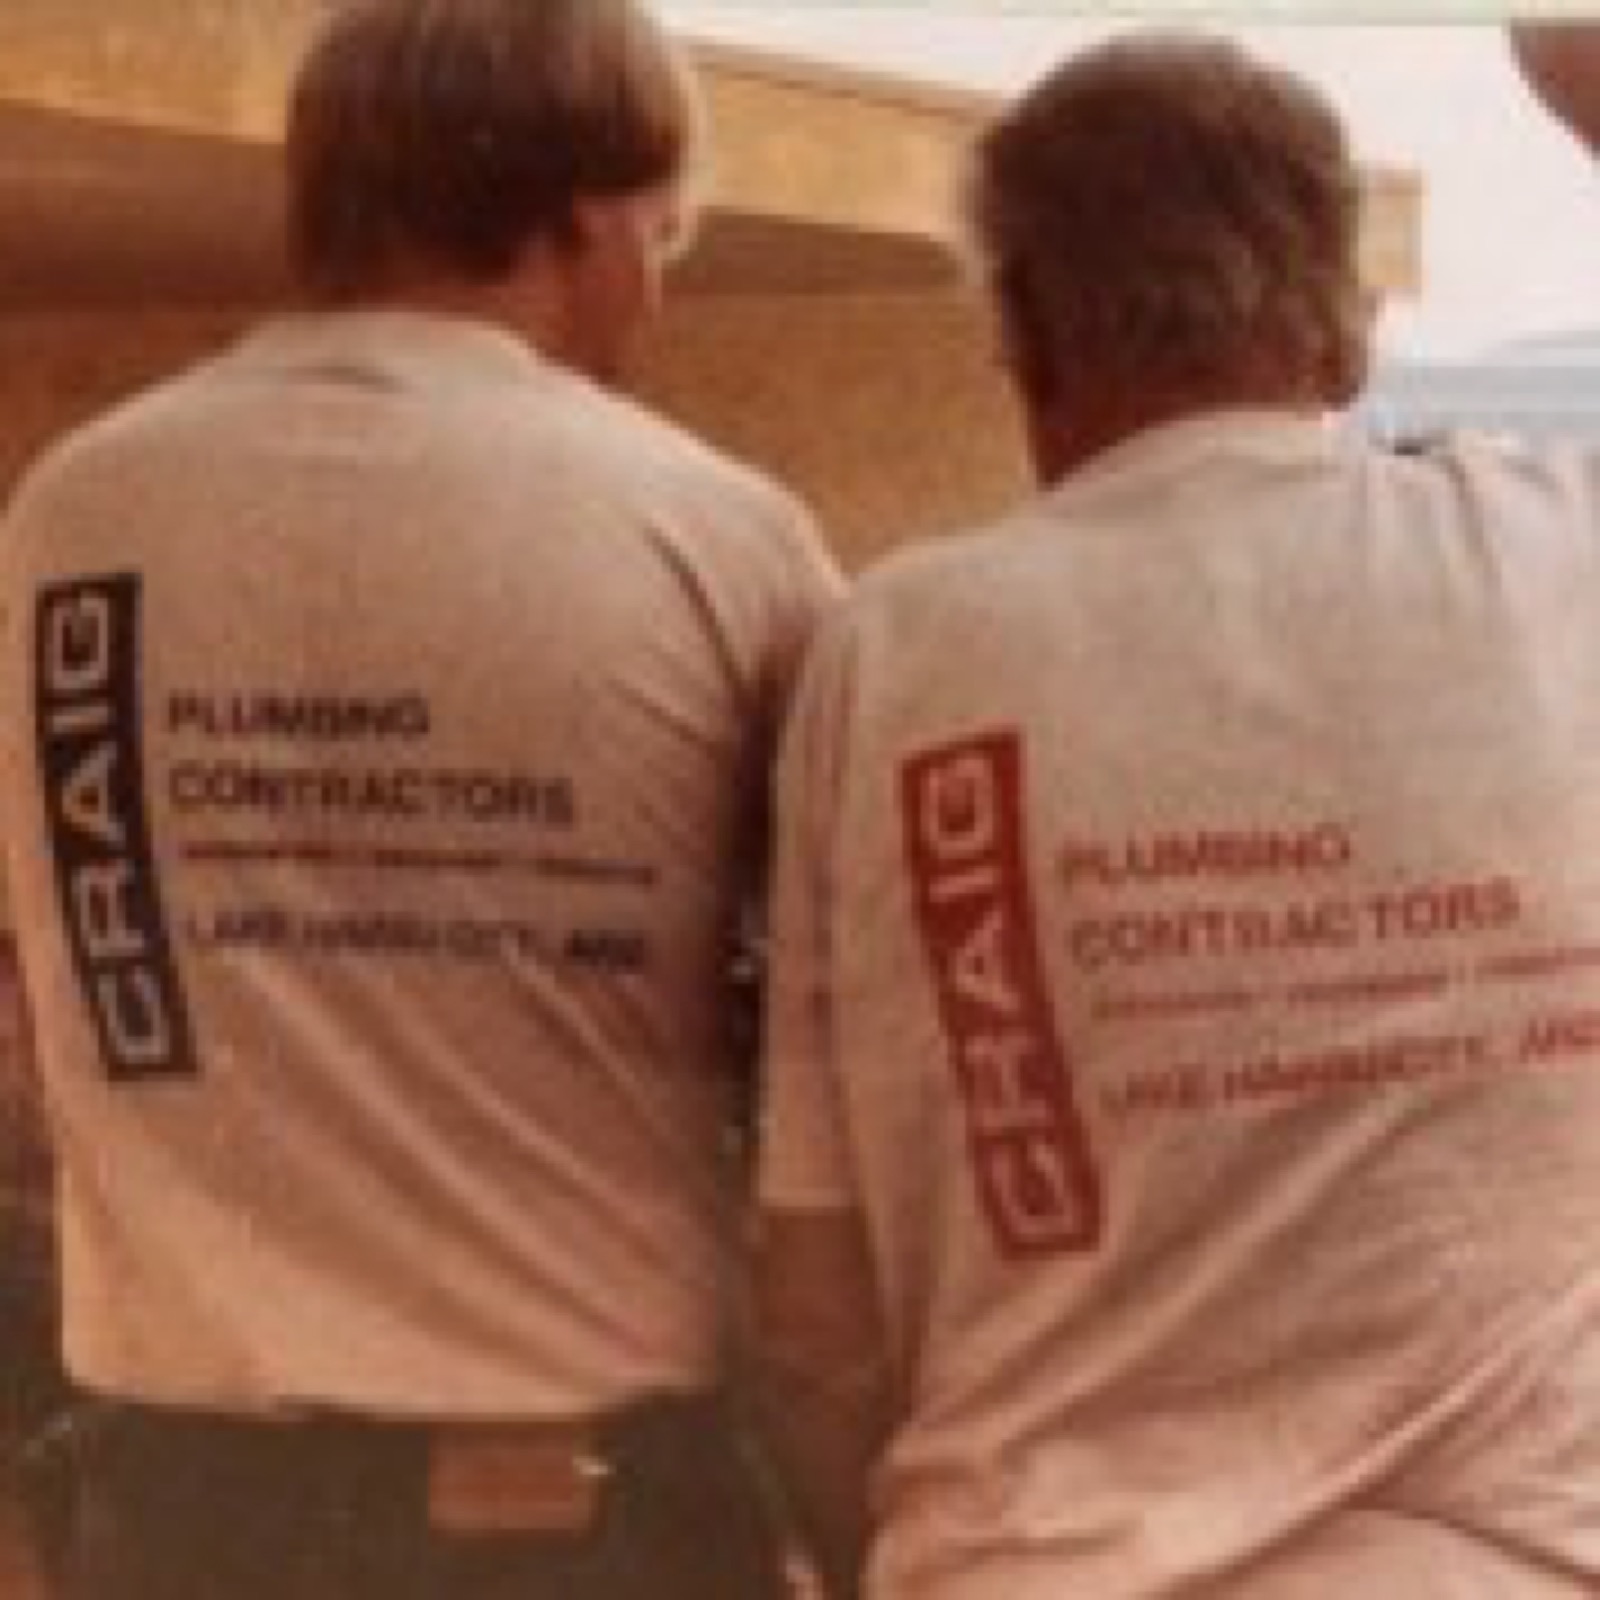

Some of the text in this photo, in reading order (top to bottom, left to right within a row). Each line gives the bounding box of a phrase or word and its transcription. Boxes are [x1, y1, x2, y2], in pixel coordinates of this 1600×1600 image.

[45, 590, 170, 1066] CRAIG
[168, 759, 574, 828] CONTRACTORS
[1070, 877, 1521, 966] CONTRACTORS
[920, 752, 1080, 1238] CRAIG
